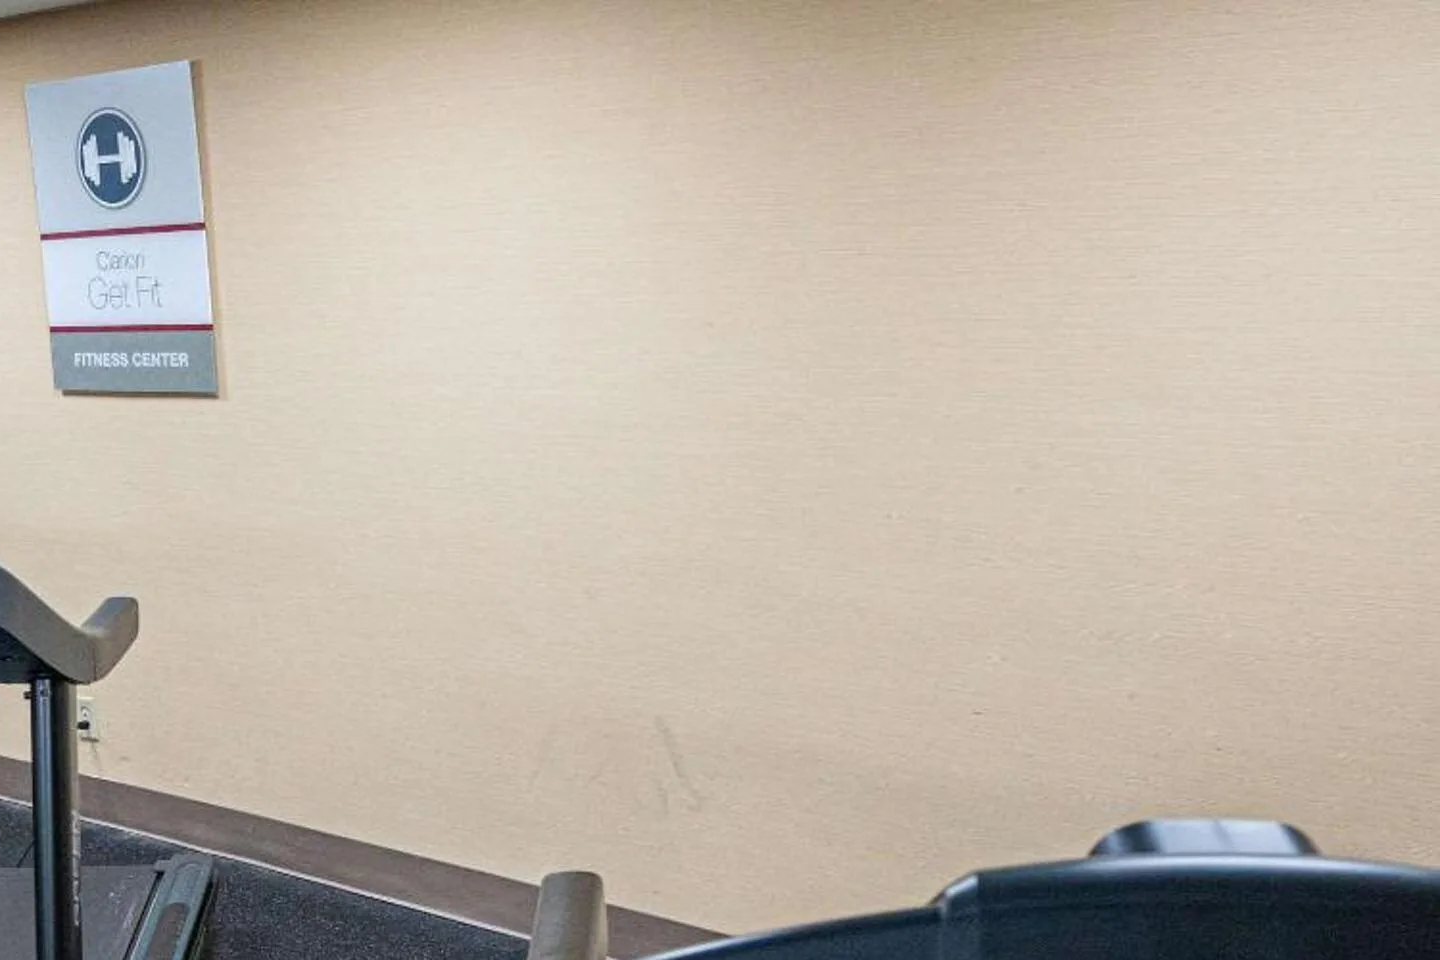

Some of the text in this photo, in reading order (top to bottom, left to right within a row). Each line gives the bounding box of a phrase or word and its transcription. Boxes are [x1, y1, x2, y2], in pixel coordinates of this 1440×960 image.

[87, 275, 164, 310] Get Fit
[73, 352, 189, 368] FITNESS CENTER
